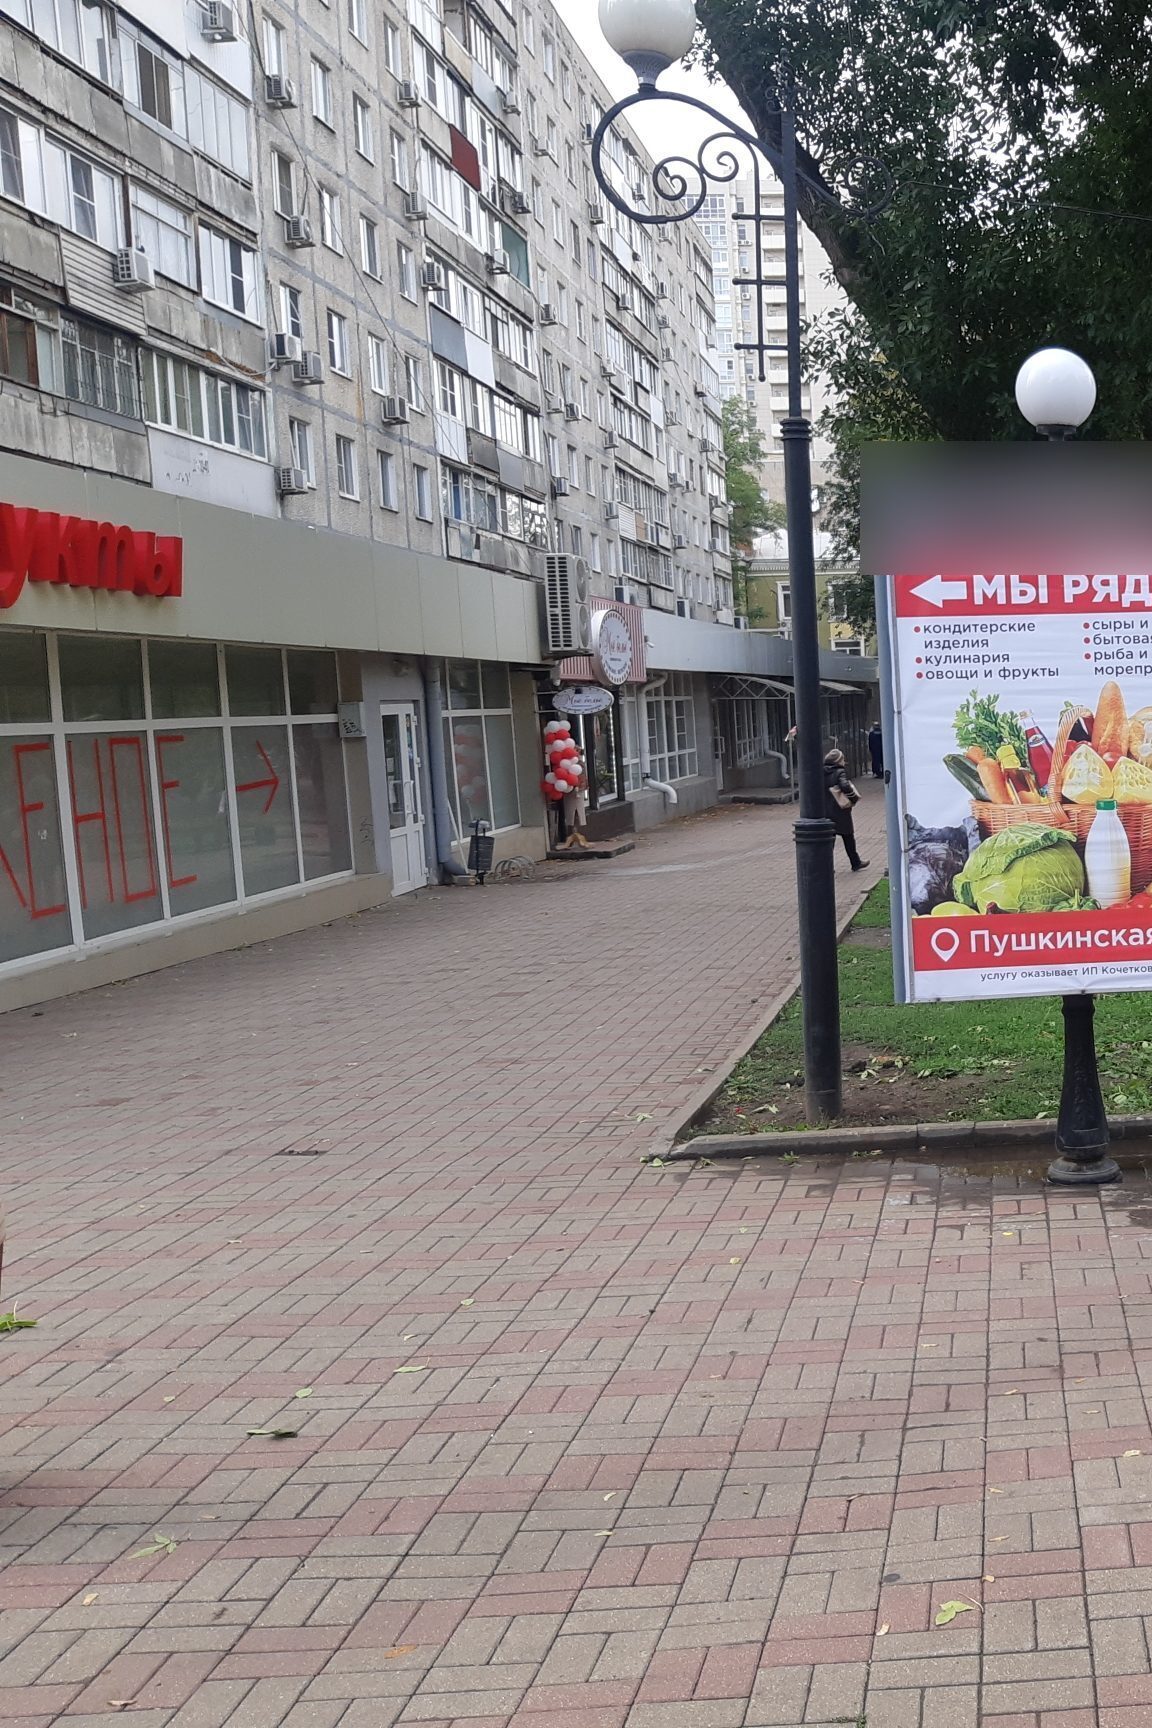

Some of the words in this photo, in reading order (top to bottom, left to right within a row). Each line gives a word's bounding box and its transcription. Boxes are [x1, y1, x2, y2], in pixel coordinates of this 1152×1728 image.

[973, 574, 1049, 605] МЫ
[923, 621, 1036, 636] кондитерские
[1092, 619, 1134, 632] сыры
[1140, 619, 1149, 629] и
[924, 637, 989, 651] изделия
[925, 652, 1010, 667] кулинария
[1094, 649, 1134, 663] рыба
[1139, 649, 1148, 660] и
[925, 668, 979, 681] овощи
[984, 668, 993, 679] и
[999, 666, 1059, 680] фрукты
[980, 971, 1018, 982] услугу
[1020, 967, 1078, 980] оказывает
[1082, 965, 1098, 976] ИП
